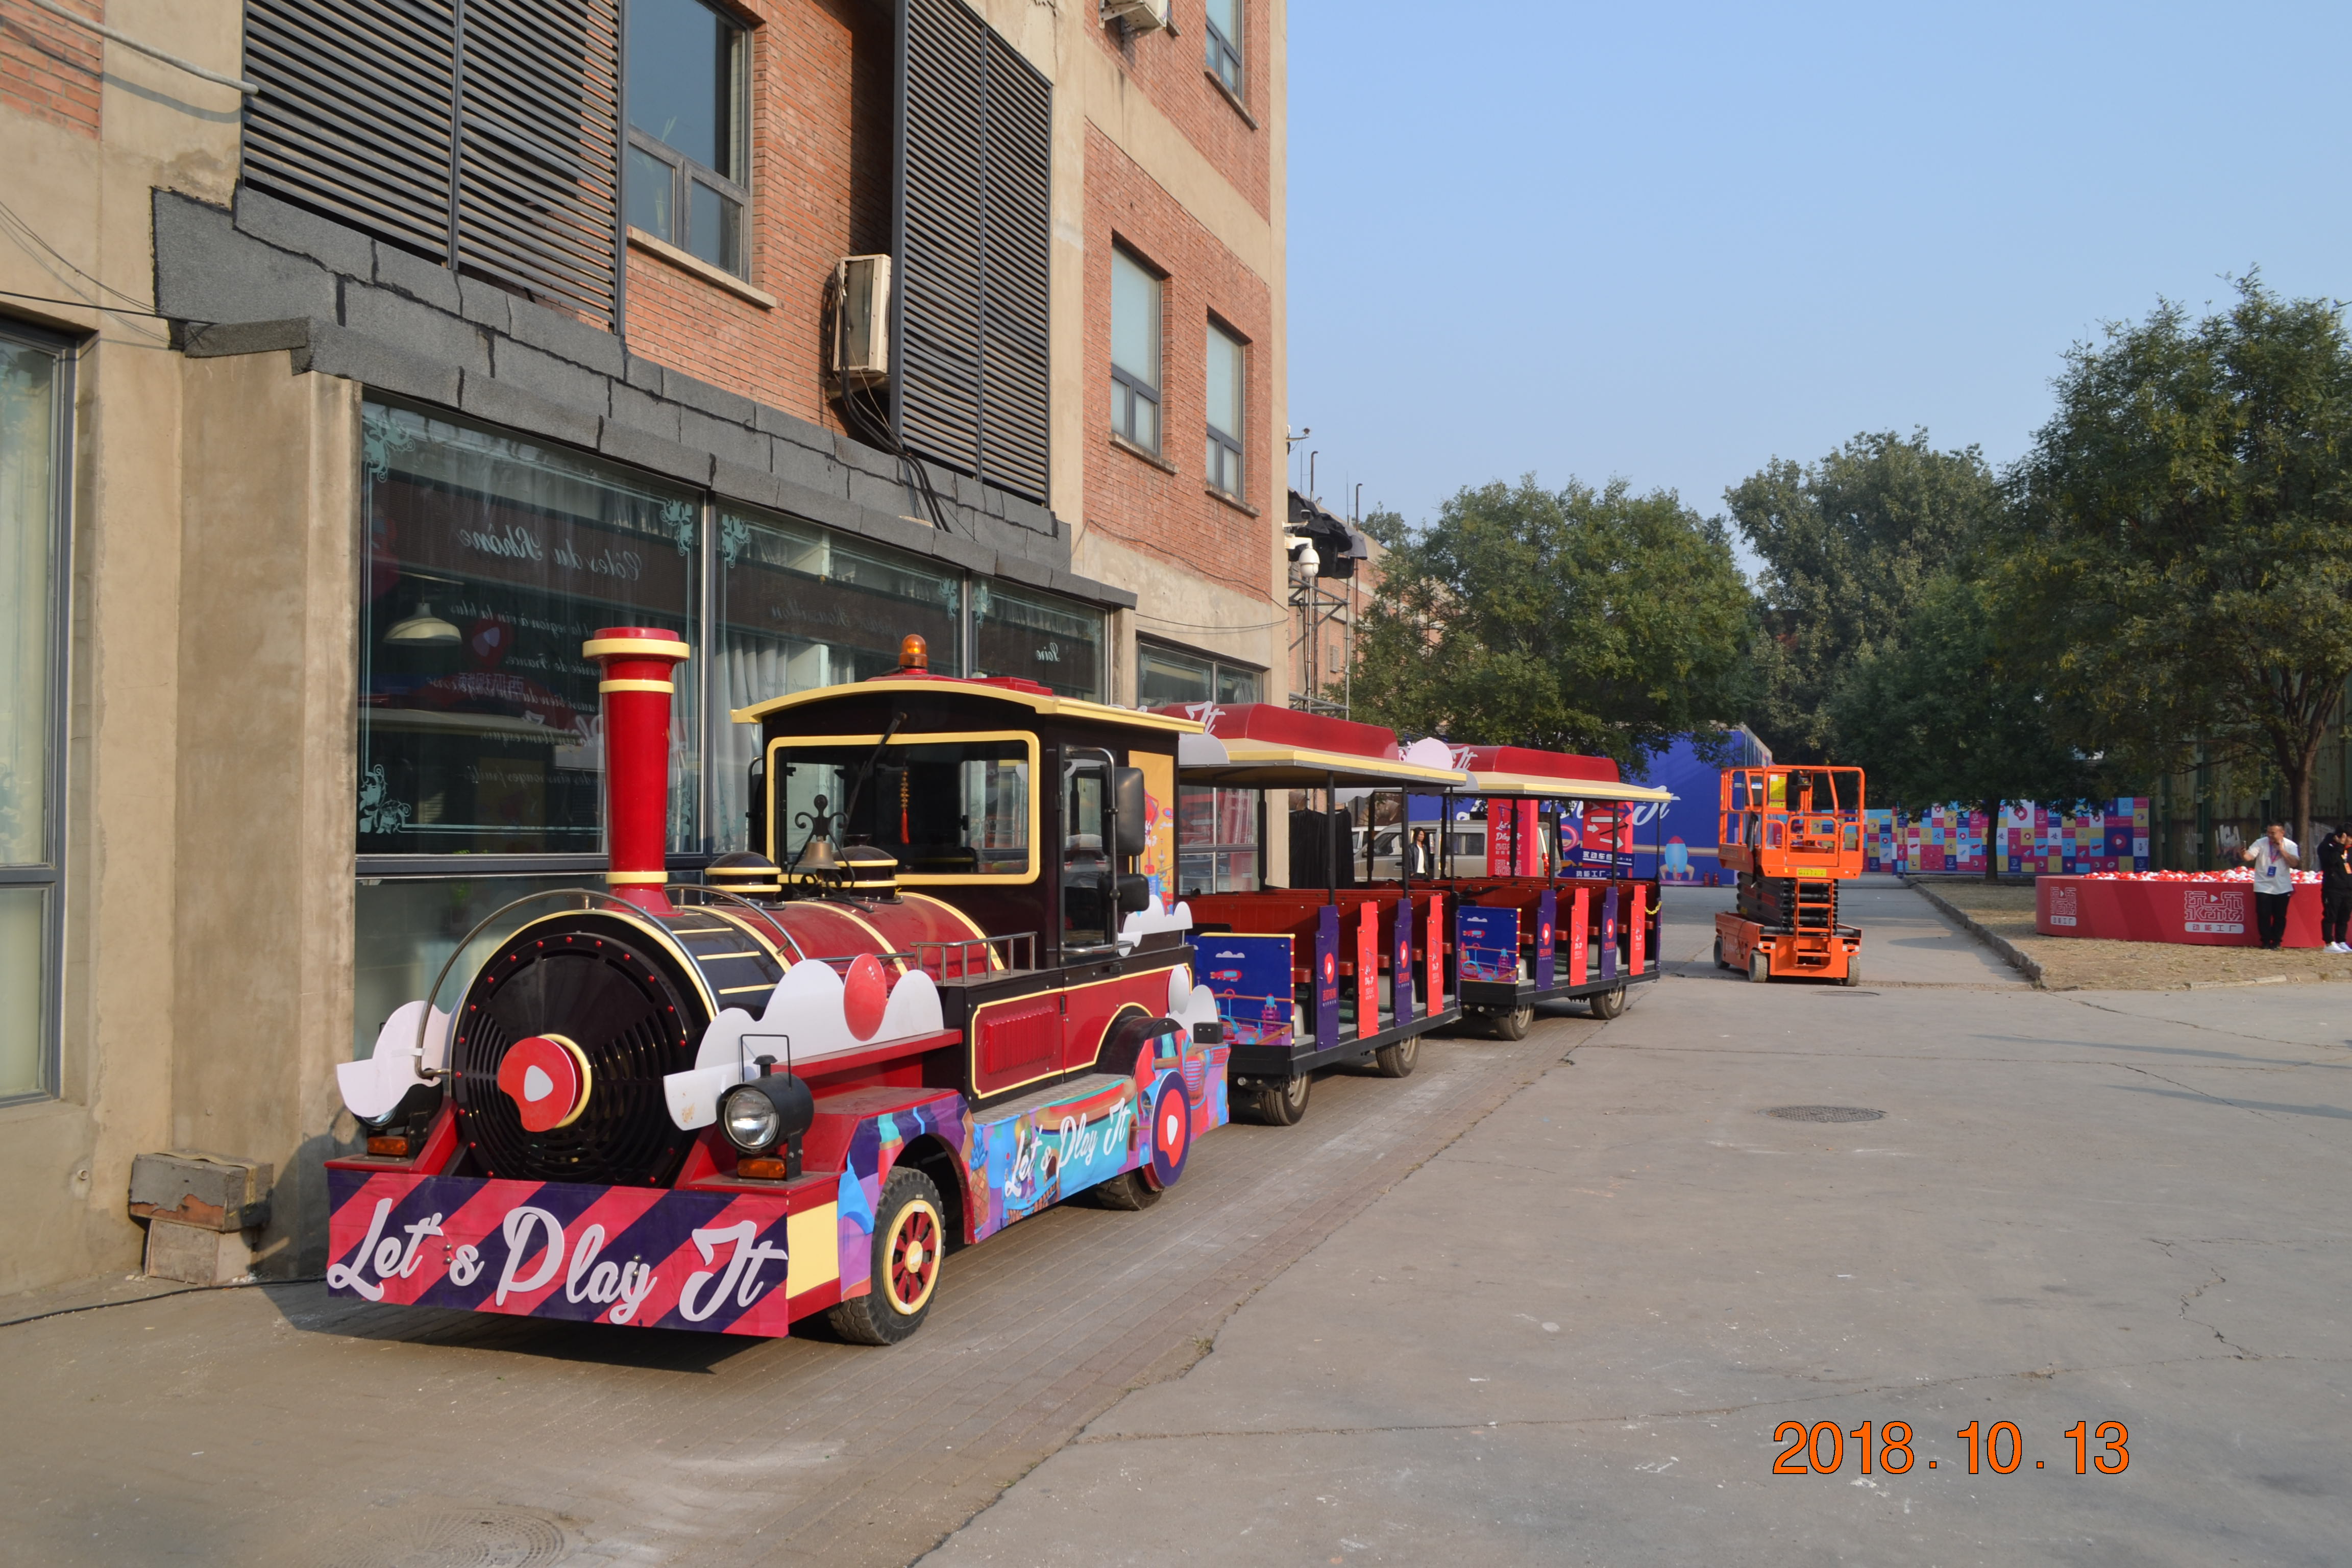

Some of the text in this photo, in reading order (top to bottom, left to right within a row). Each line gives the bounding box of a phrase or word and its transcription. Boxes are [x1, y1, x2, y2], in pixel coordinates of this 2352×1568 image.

[2193, 924, 2237, 932] 动能工厂
[1004, 1097, 1131, 1197] Let's Play It
[327, 1198, 788, 1325] Let's Play It
